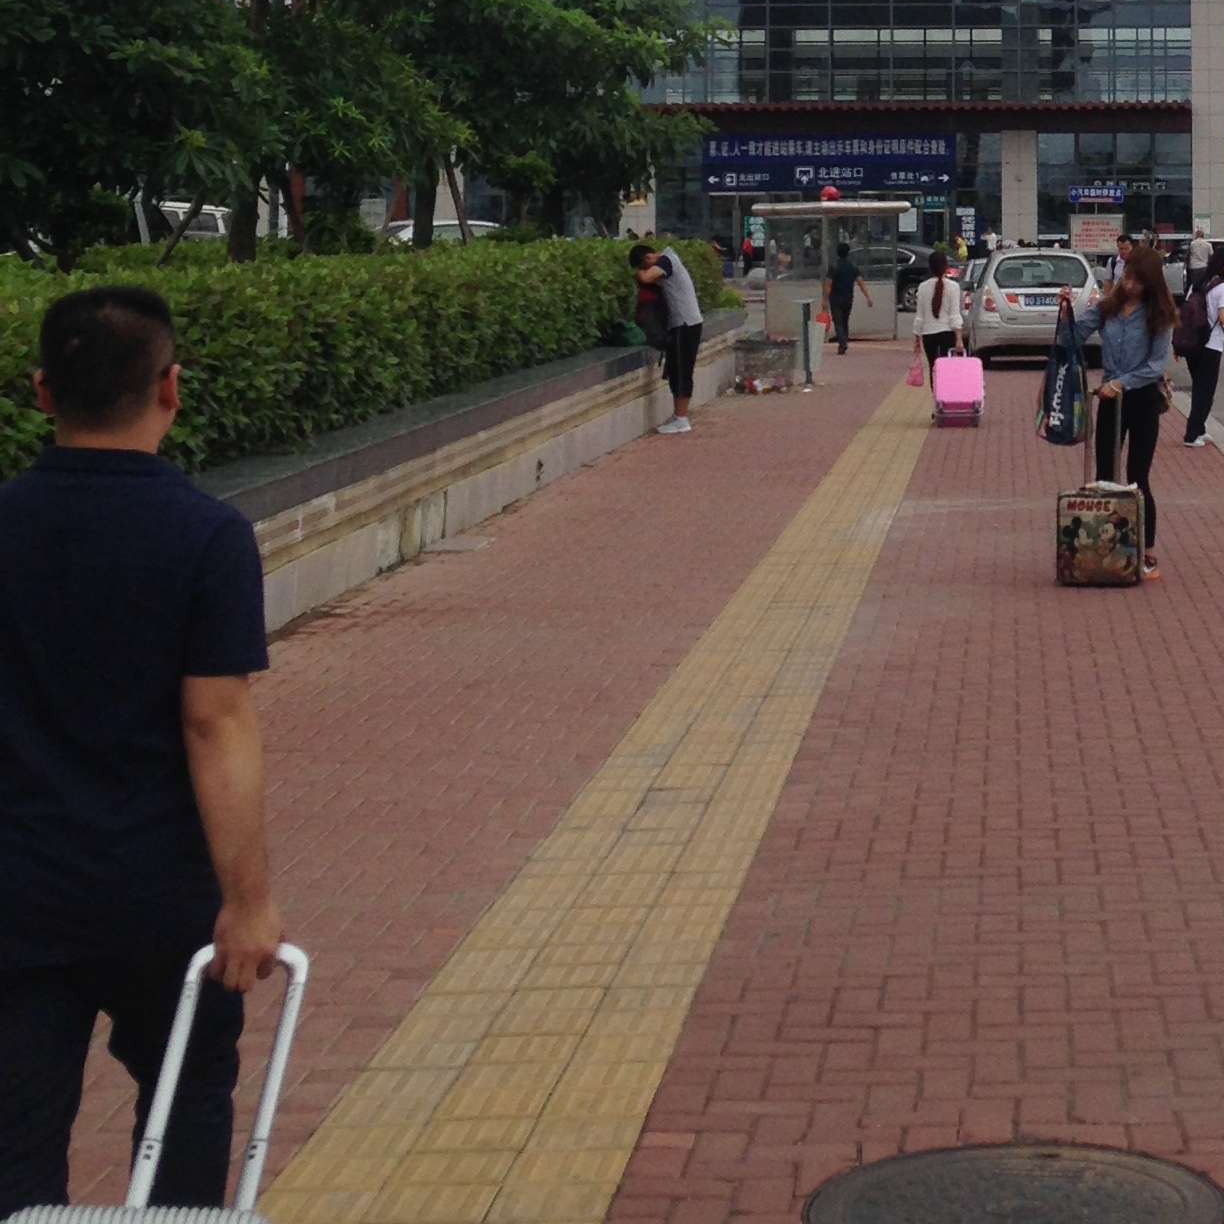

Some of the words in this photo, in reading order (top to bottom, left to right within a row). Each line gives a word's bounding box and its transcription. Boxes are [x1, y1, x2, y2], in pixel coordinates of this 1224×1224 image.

[818, 167, 864, 178] 北进站口
[1066, 500, 1111, 512] MOUSE
